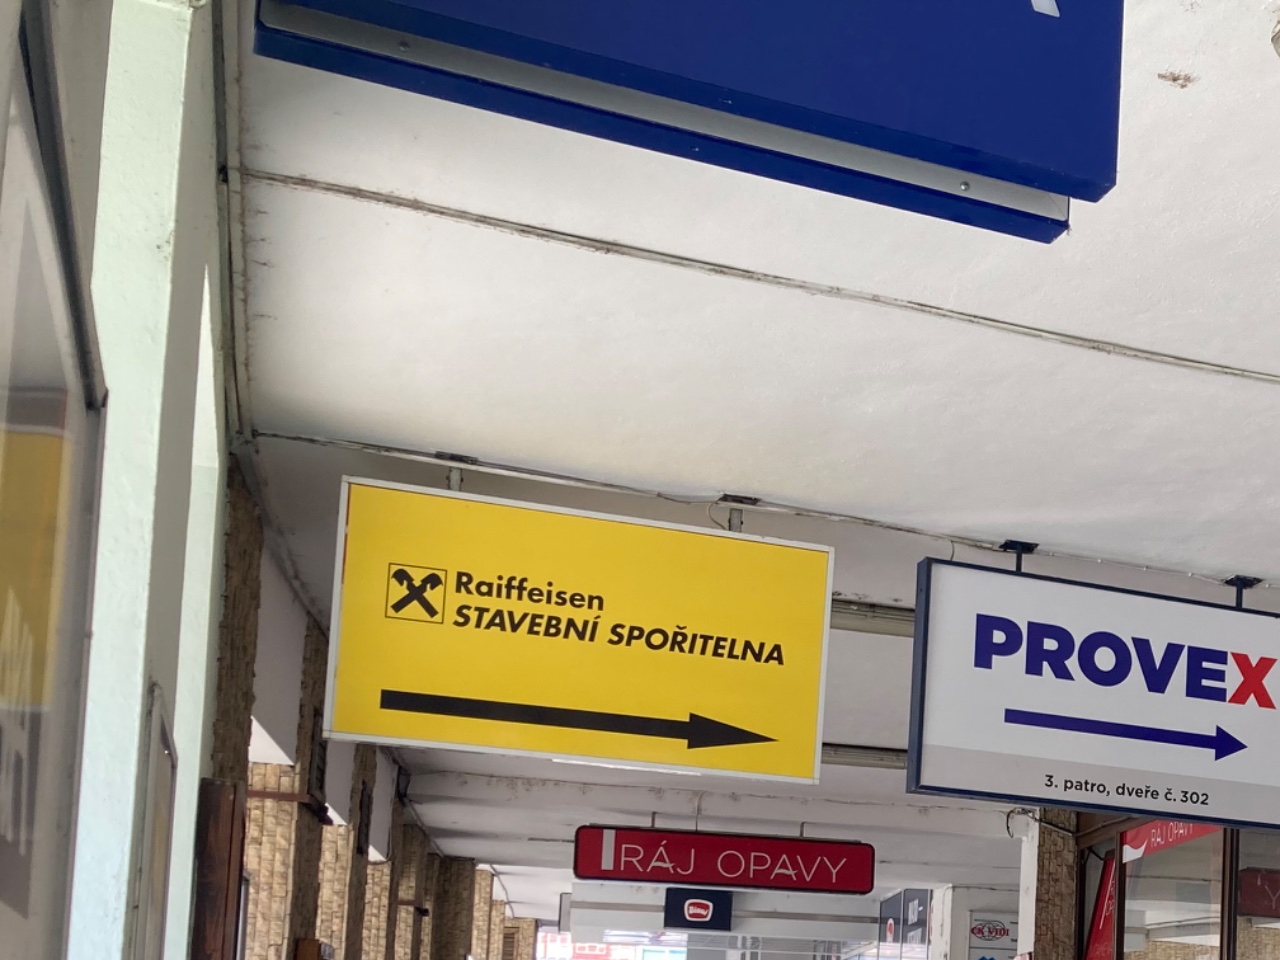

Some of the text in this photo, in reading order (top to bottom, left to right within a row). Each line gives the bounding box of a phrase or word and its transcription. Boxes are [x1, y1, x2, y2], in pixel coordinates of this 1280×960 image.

[455, 571, 604, 611] Raiffeisen
[453, 604, 785, 665] STAVEBNÍ SPOŘITELNA
[973, 613, 1277, 710] PROVEX
[1044, 774, 1209, 806] 3. patro, dveře č. 302
[620, 840, 848, 884] RÁJ OPAVY
